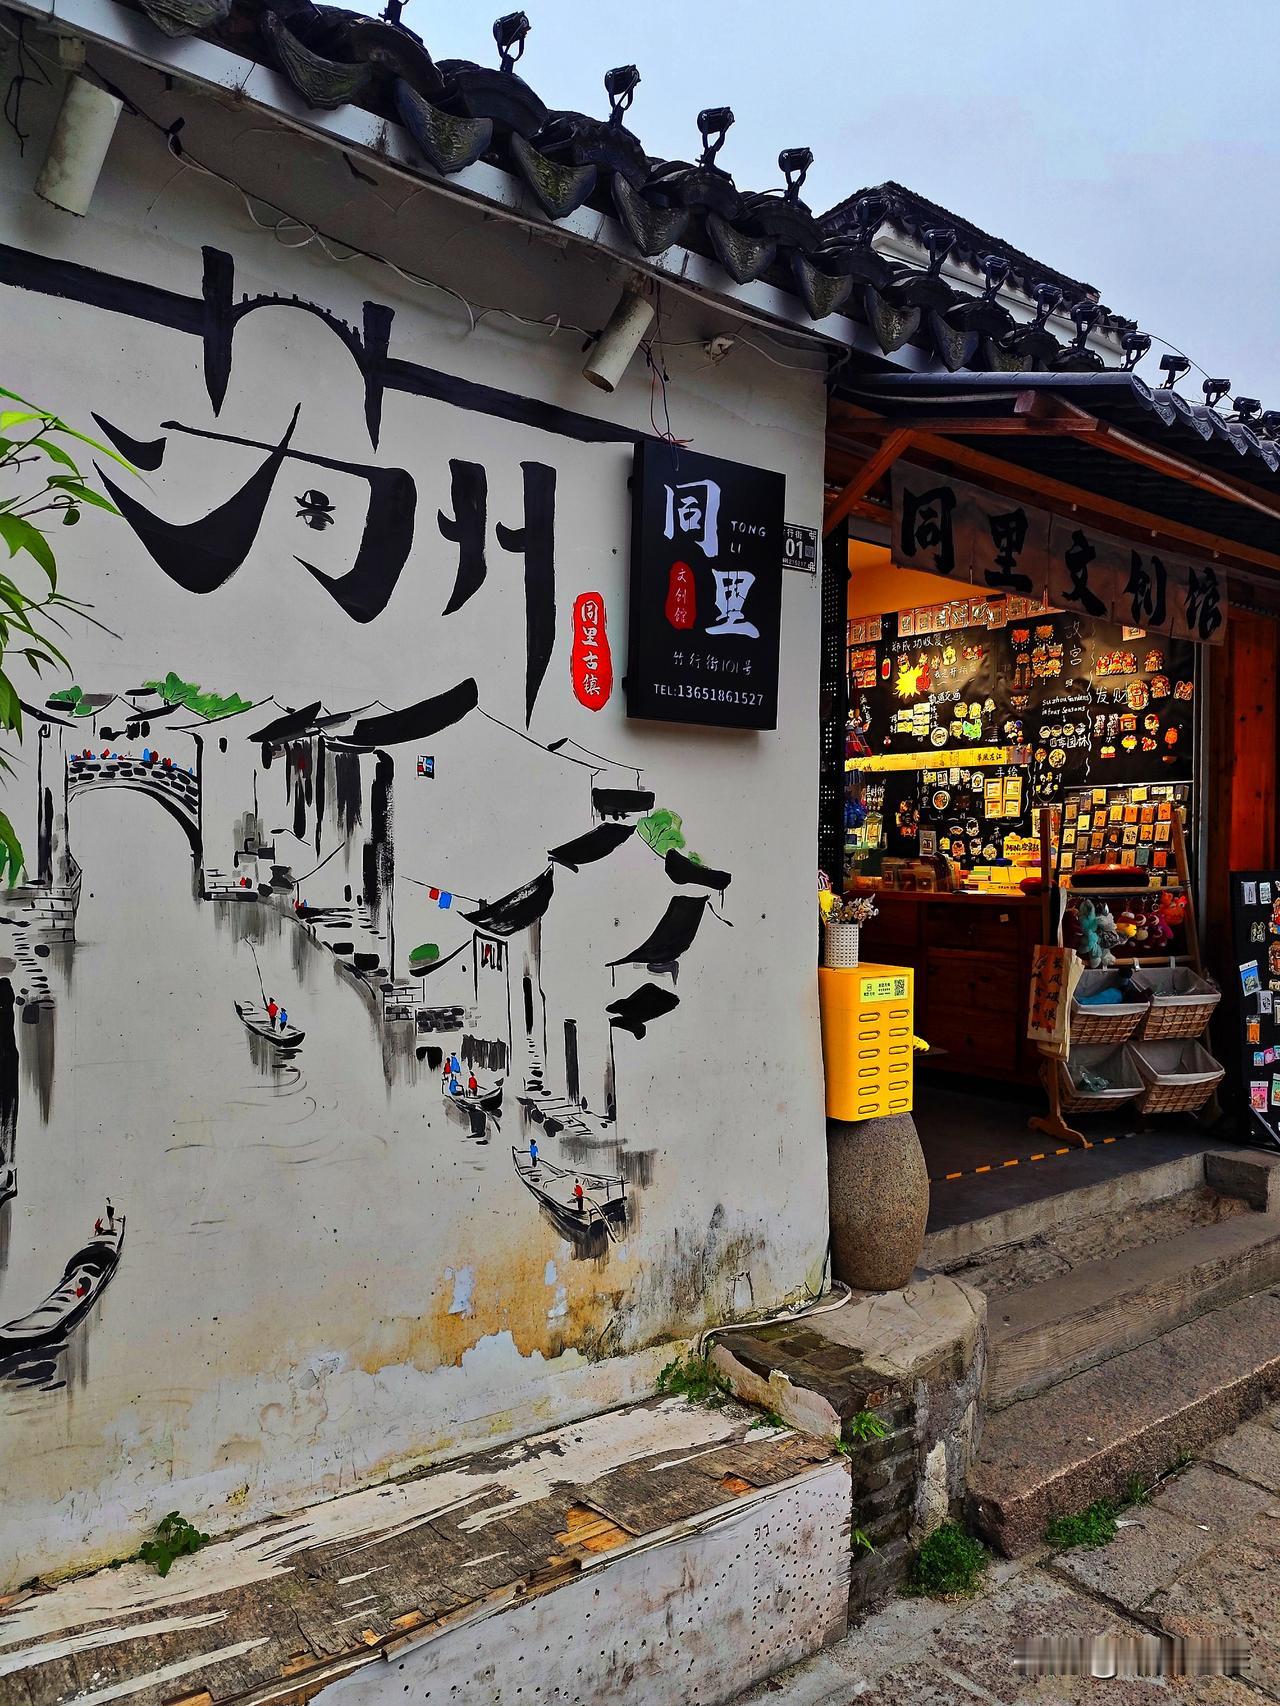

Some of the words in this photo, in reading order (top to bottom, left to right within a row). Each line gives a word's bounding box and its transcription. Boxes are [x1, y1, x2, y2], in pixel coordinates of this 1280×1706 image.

[730, 519, 767, 537] TONG
[730, 545, 741, 554] LI
[785, 538, 803, 559] 01
[580, 600, 601, 696] 同里古镇
[673, 651, 752, 677] 竹行街101号
[653, 683, 764, 707] TEL:13651861527
